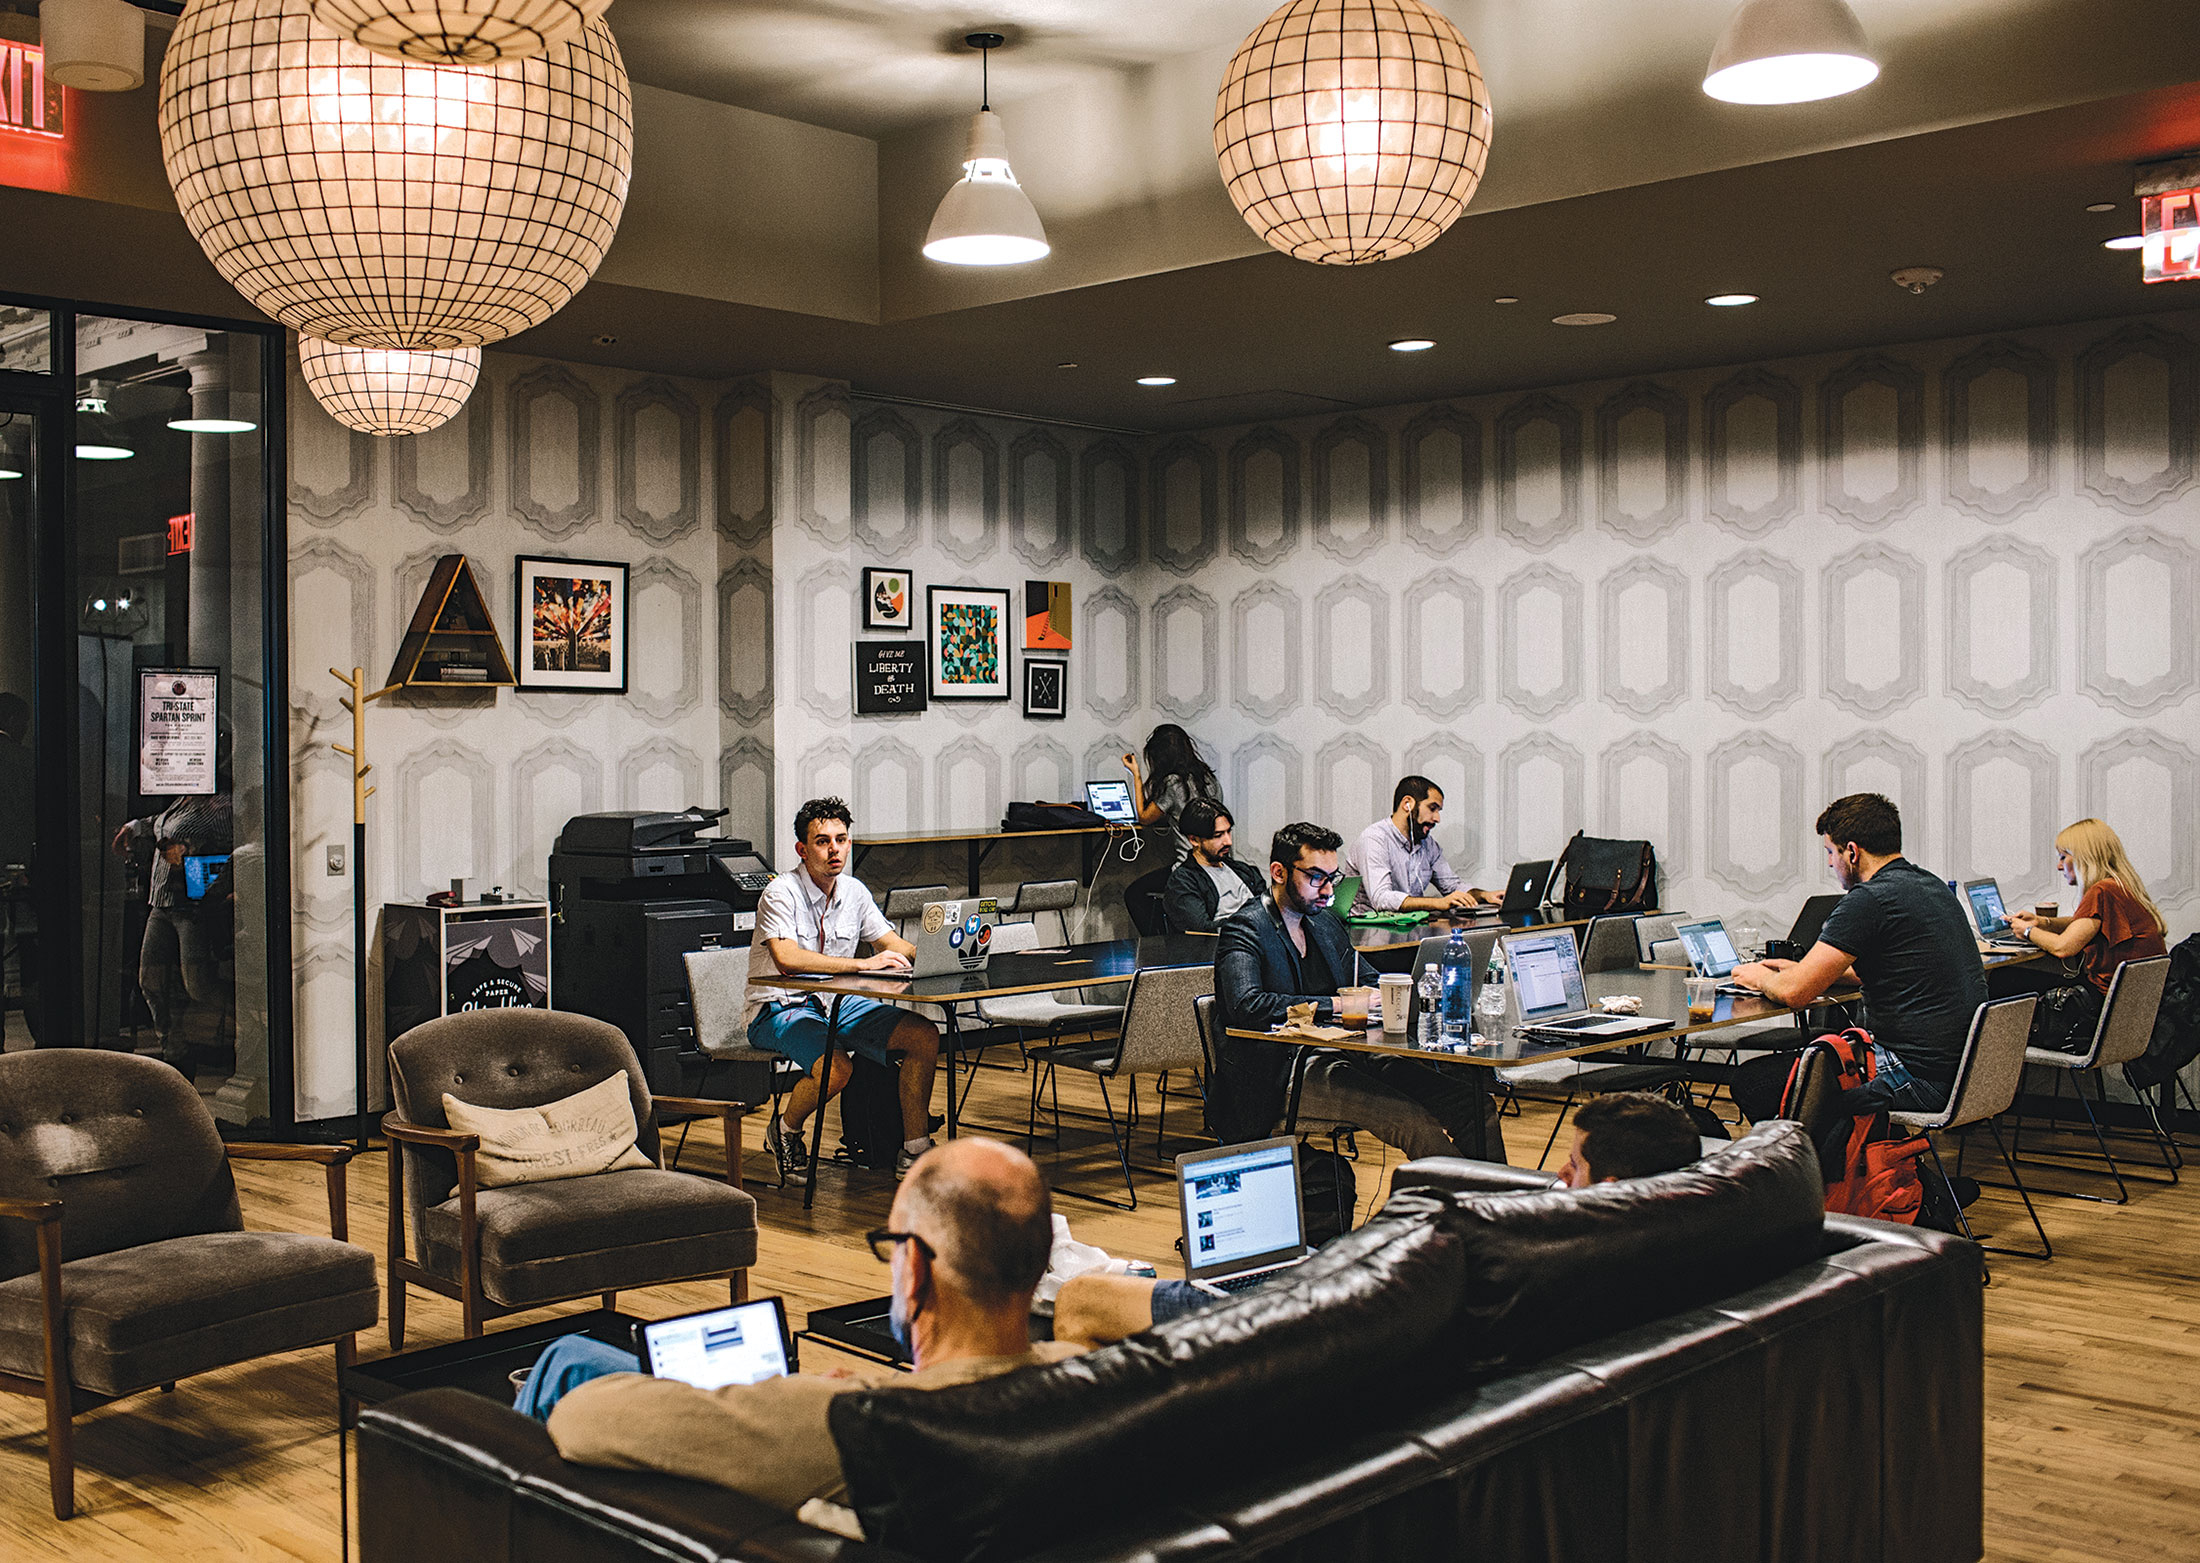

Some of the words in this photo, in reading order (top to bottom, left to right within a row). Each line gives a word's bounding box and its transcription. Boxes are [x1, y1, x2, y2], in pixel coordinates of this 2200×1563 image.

[2161, 193, 2200, 275] E
[877, 649, 894, 659] GIVE
[868, 662, 914, 673] LIBERTY
[873, 683, 915, 695] DEATH
[162, 701, 195, 711] TRI-STATE
[150, 712, 180, 723] SPARTAN
[181, 712, 206, 722] SPRINT
[471, 982, 487, 997] SAFE
[497, 978, 522, 993] SECURE
